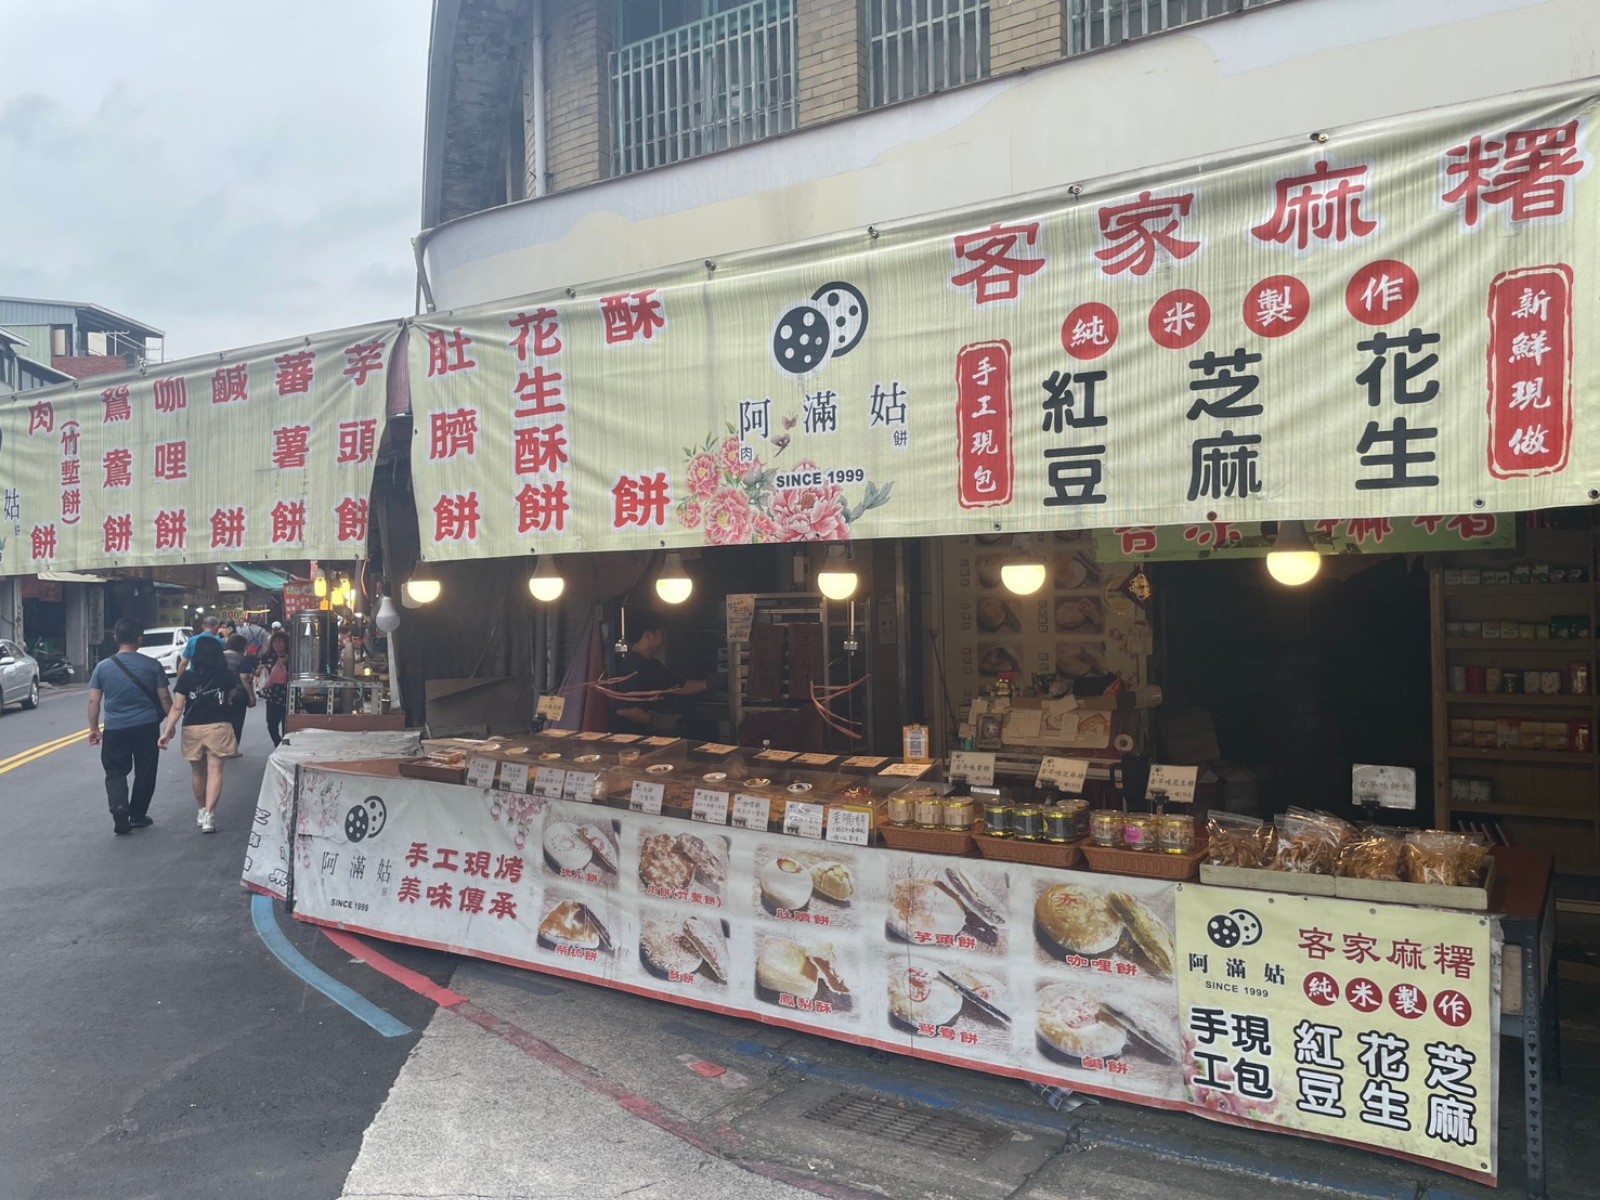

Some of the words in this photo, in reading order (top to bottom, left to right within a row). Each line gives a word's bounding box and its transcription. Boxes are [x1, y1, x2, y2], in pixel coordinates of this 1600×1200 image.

[951, 120, 1584, 304] 客家麻糬
[1069, 273, 1405, 349] 純米製作
[509, 308, 569, 532] 花生酥餅
[600, 289, 670, 527] 酥餅
[739, 382, 907, 441] 阿滿姑
[1355, 328, 1441, 490] 花生
[1508, 287, 1552, 456] 新鮮現做
[154, 377, 187, 549] 咖哩餅
[210, 363, 247, 548] 鹹餅
[335, 341, 385, 542] 芋頭餅
[428, 327, 480, 541] 肚臍餅
[971, 356, 999, 493] 手工現包
[1042, 370, 1108, 507] 紅豆
[1186, 347, 1264, 501] 芝麻
[4, 488, 19, 520] 姑
[28, 401, 57, 559] 肉餅
[776, 472, 822, 488] SINCE
[827, 468, 864, 484] 1999
[321, 850, 393, 884] 阿滿姑
[330, 898, 353, 909] SINCE
[354, 900, 370, 912] 1999
[398, 876, 518, 919] 美味傳承
[405, 842, 524, 883] 手工現烤
[914, 931, 977, 950] 芋頭餅
[1066, 954, 1138, 976] 咖哩餅
[1188, 952, 1286, 985] 阿滿姑
[1205, 980, 1239, 993] SINCE
[1244, 986, 1269, 998] 1999
[1298, 927, 1476, 979] 客家麻糬
[1307, 975, 1466, 1024] 純米製作
[1293, 1019, 1346, 1118] 紅豆
[1358, 1029, 1411, 1131] 花生
[1423, 1041, 1477, 1146] 芝麻
